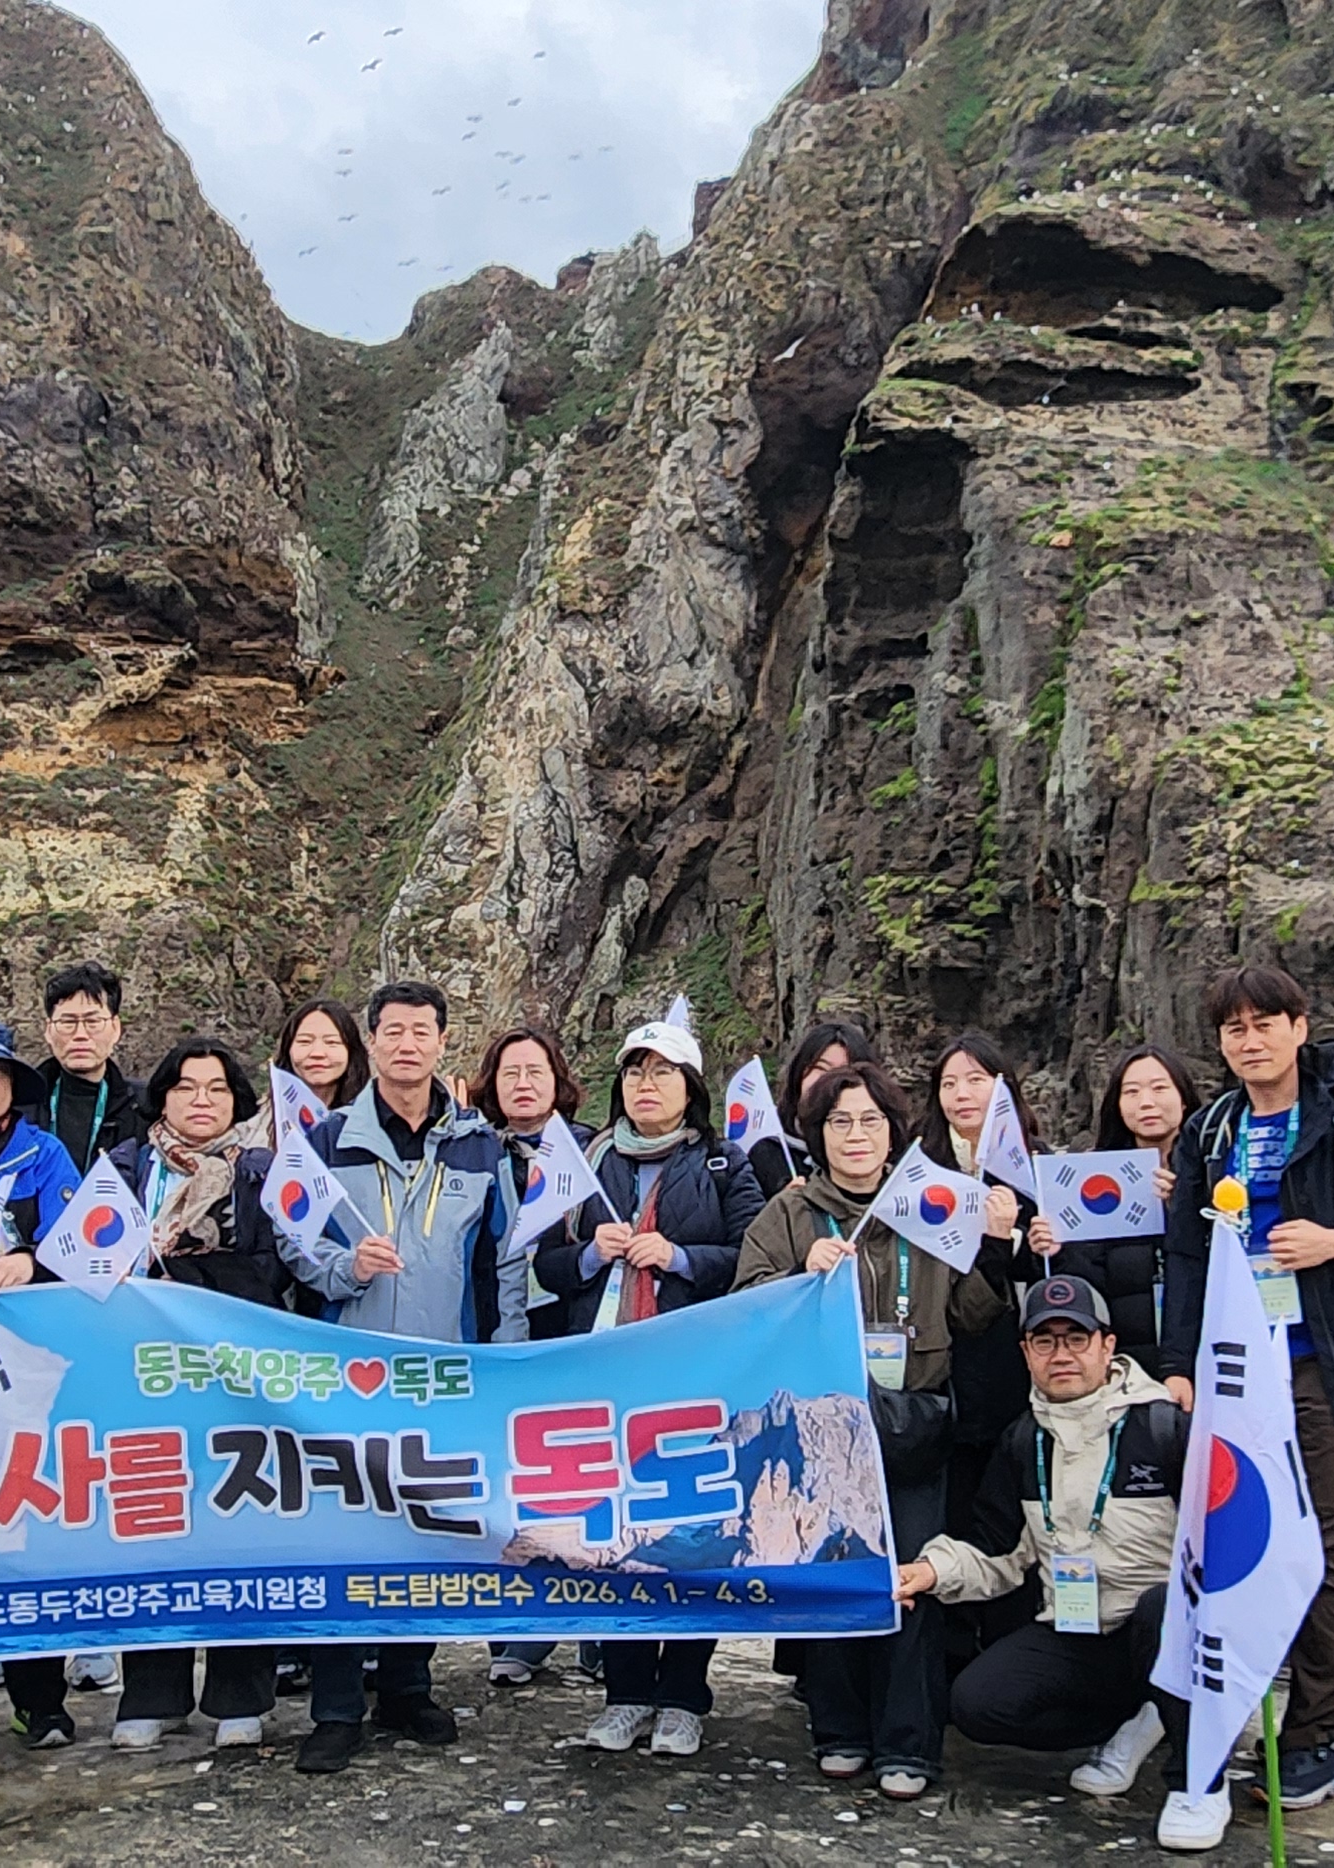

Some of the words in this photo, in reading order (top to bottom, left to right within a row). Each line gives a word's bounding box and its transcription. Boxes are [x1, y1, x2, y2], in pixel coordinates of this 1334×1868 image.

[136, 1343, 342, 1401] 동두천양주
[393, 1355, 472, 1403] 독도
[210, 1428, 484, 1537] 지키는
[510, 1402, 741, 1544] 독도
[345, 1573, 535, 1609] 독도탐방연수
[543, 1576, 624, 1604] 2026.
[630, 1581, 657, 1604] 4.
[715, 1581, 742, 1604] 4.
[747, 1579, 775, 1604] 3.
